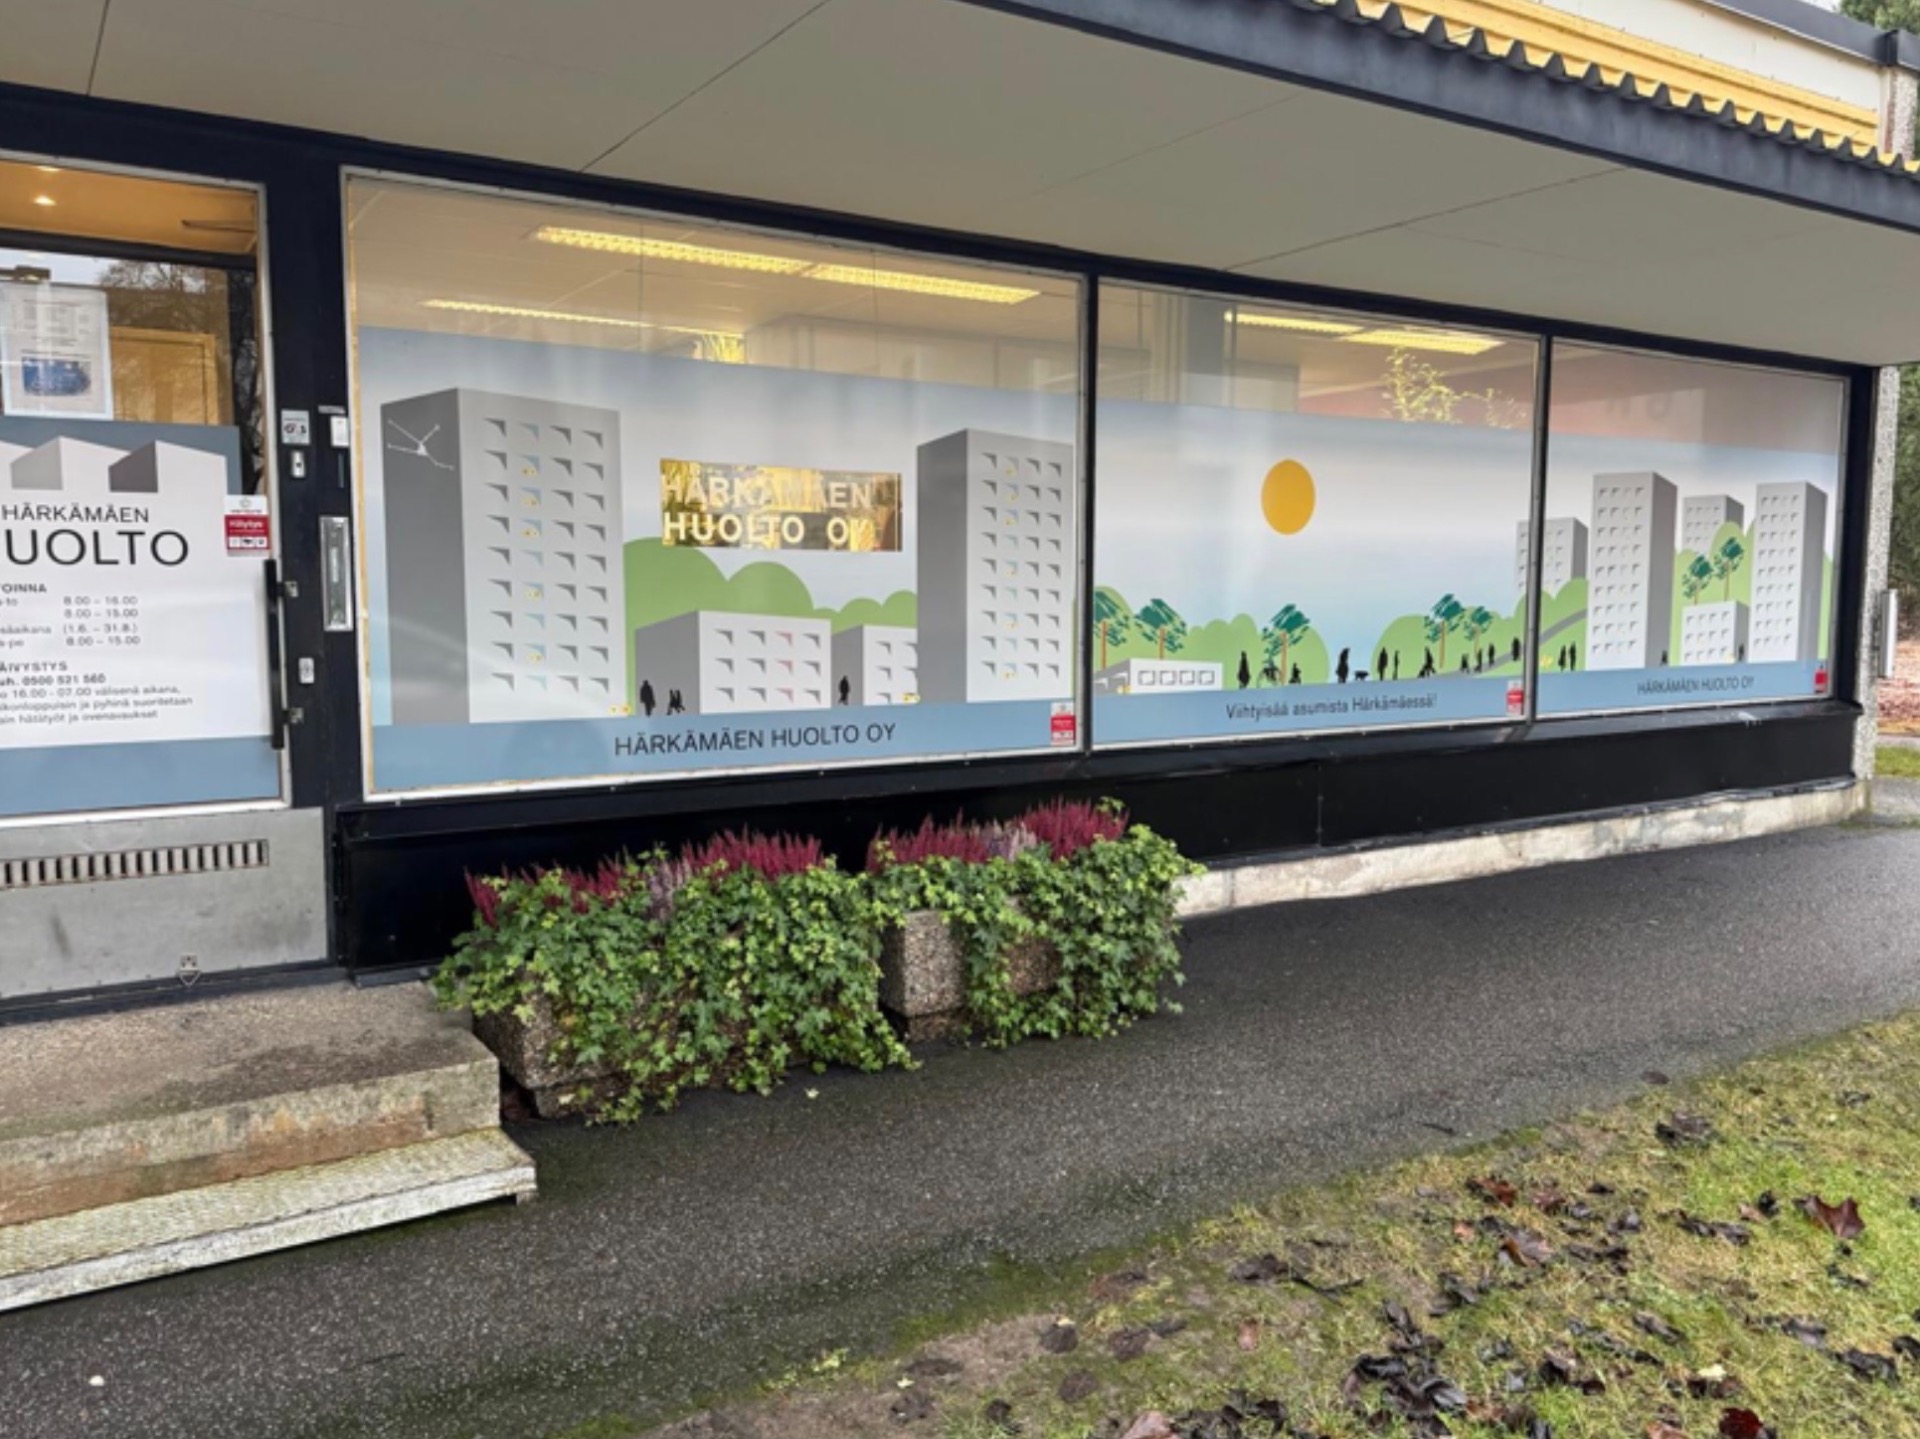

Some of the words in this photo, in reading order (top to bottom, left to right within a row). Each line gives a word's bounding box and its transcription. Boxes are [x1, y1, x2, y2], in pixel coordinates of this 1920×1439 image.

[2, 502, 149, 523] HÄRKÄMÄEN
[664, 511, 805, 543] HUOLTO
[4, 528, 189, 566] UOLTO
[0, 583, 47, 593] OINNA
[615, 726, 764, 756] HÄRKÄMÄEN
[771, 724, 859, 747] HUOLTO
[866, 722, 897, 742] OY
